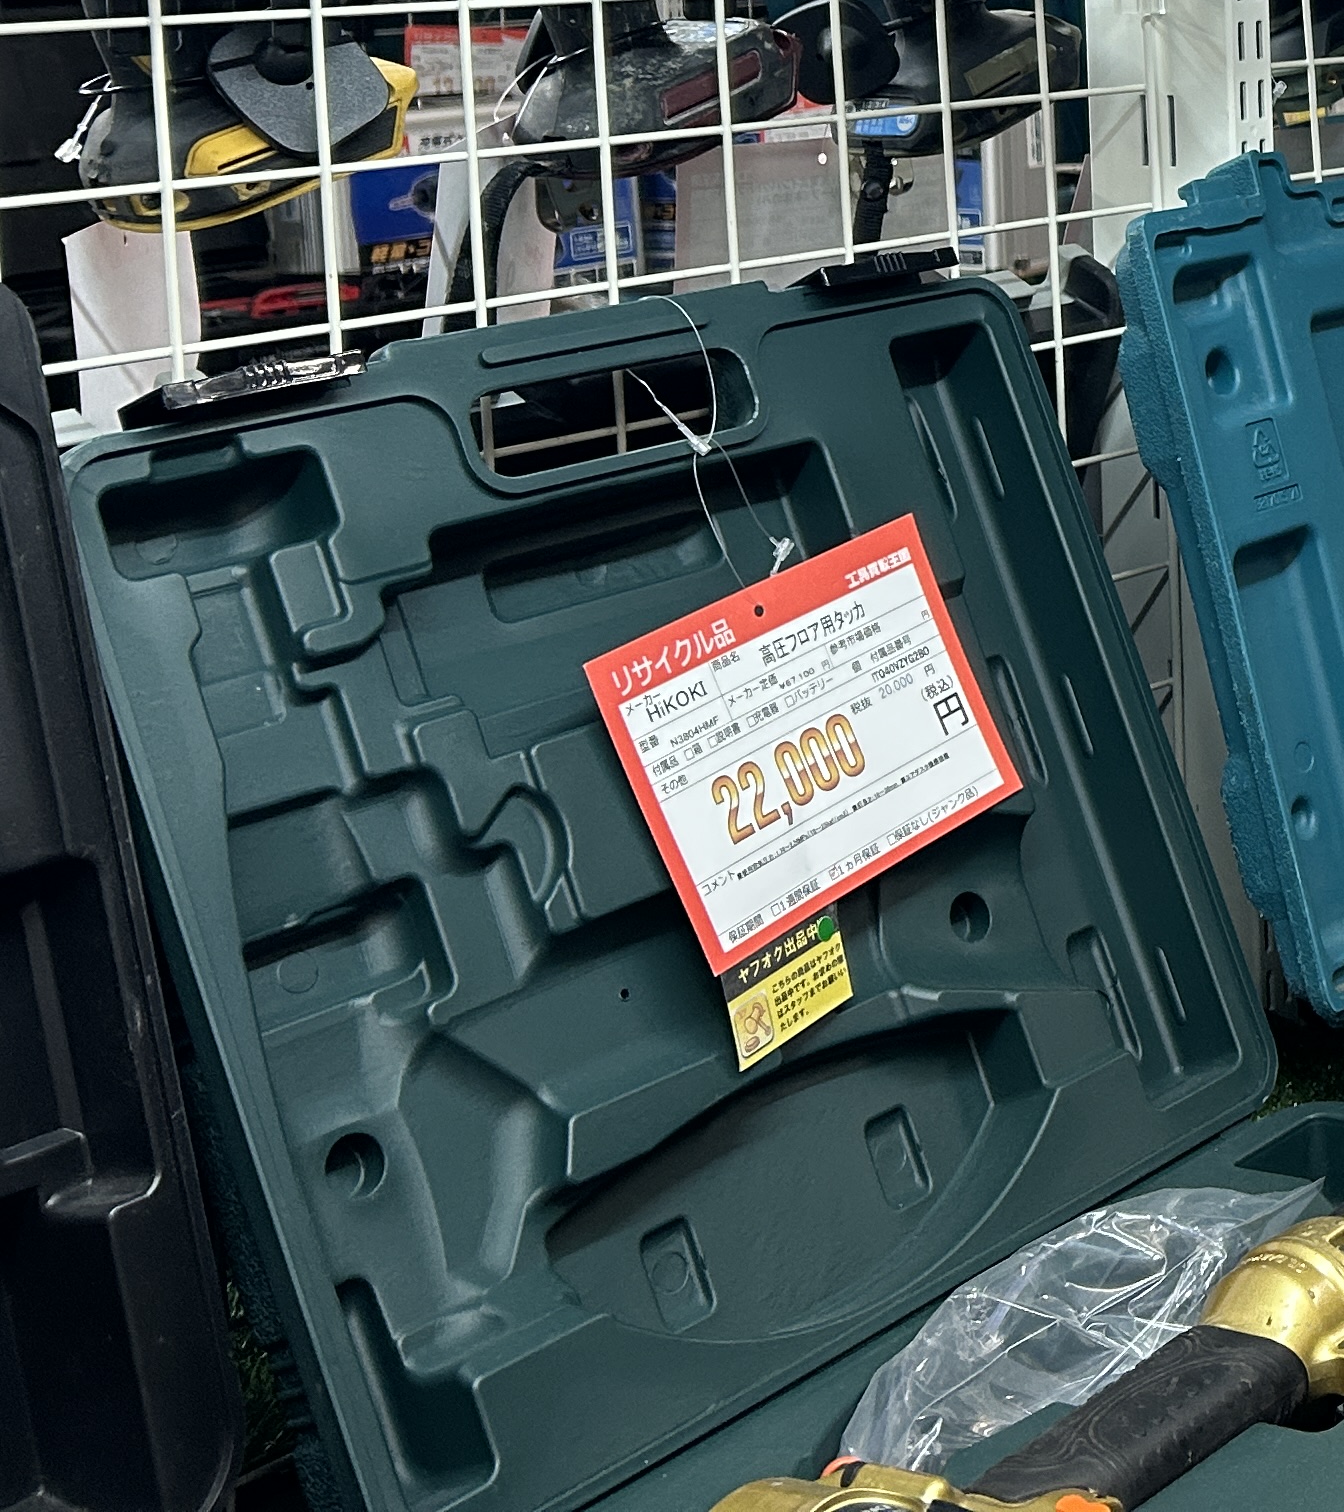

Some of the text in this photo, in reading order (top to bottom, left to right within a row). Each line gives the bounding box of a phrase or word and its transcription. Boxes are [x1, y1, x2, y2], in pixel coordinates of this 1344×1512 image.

[759, 600, 865, 667] 高圧フロア用タッカ
[829, 622, 882, 655] 参考市場価格
[611, 618, 736, 696] リサイクル品
[710, 651, 741, 672] 商品名
[924, 663, 936, 677] 円
[625, 692, 660, 717] メーカー
[645, 680, 708, 723] HiKOKI
[727, 673, 778, 707] メーカー定価
[920, 675, 954, 702] (税込)
[652, 755, 680, 778] 付属品
[792, 675, 834, 703] バッテリー
[933, 691, 970, 736] 円
[661, 774, 689, 794] その他
[711, 712, 867, 845] 22,000
[701, 868, 736, 897] コメント
[738, 917, 824, 984] ヤフオク出品中
